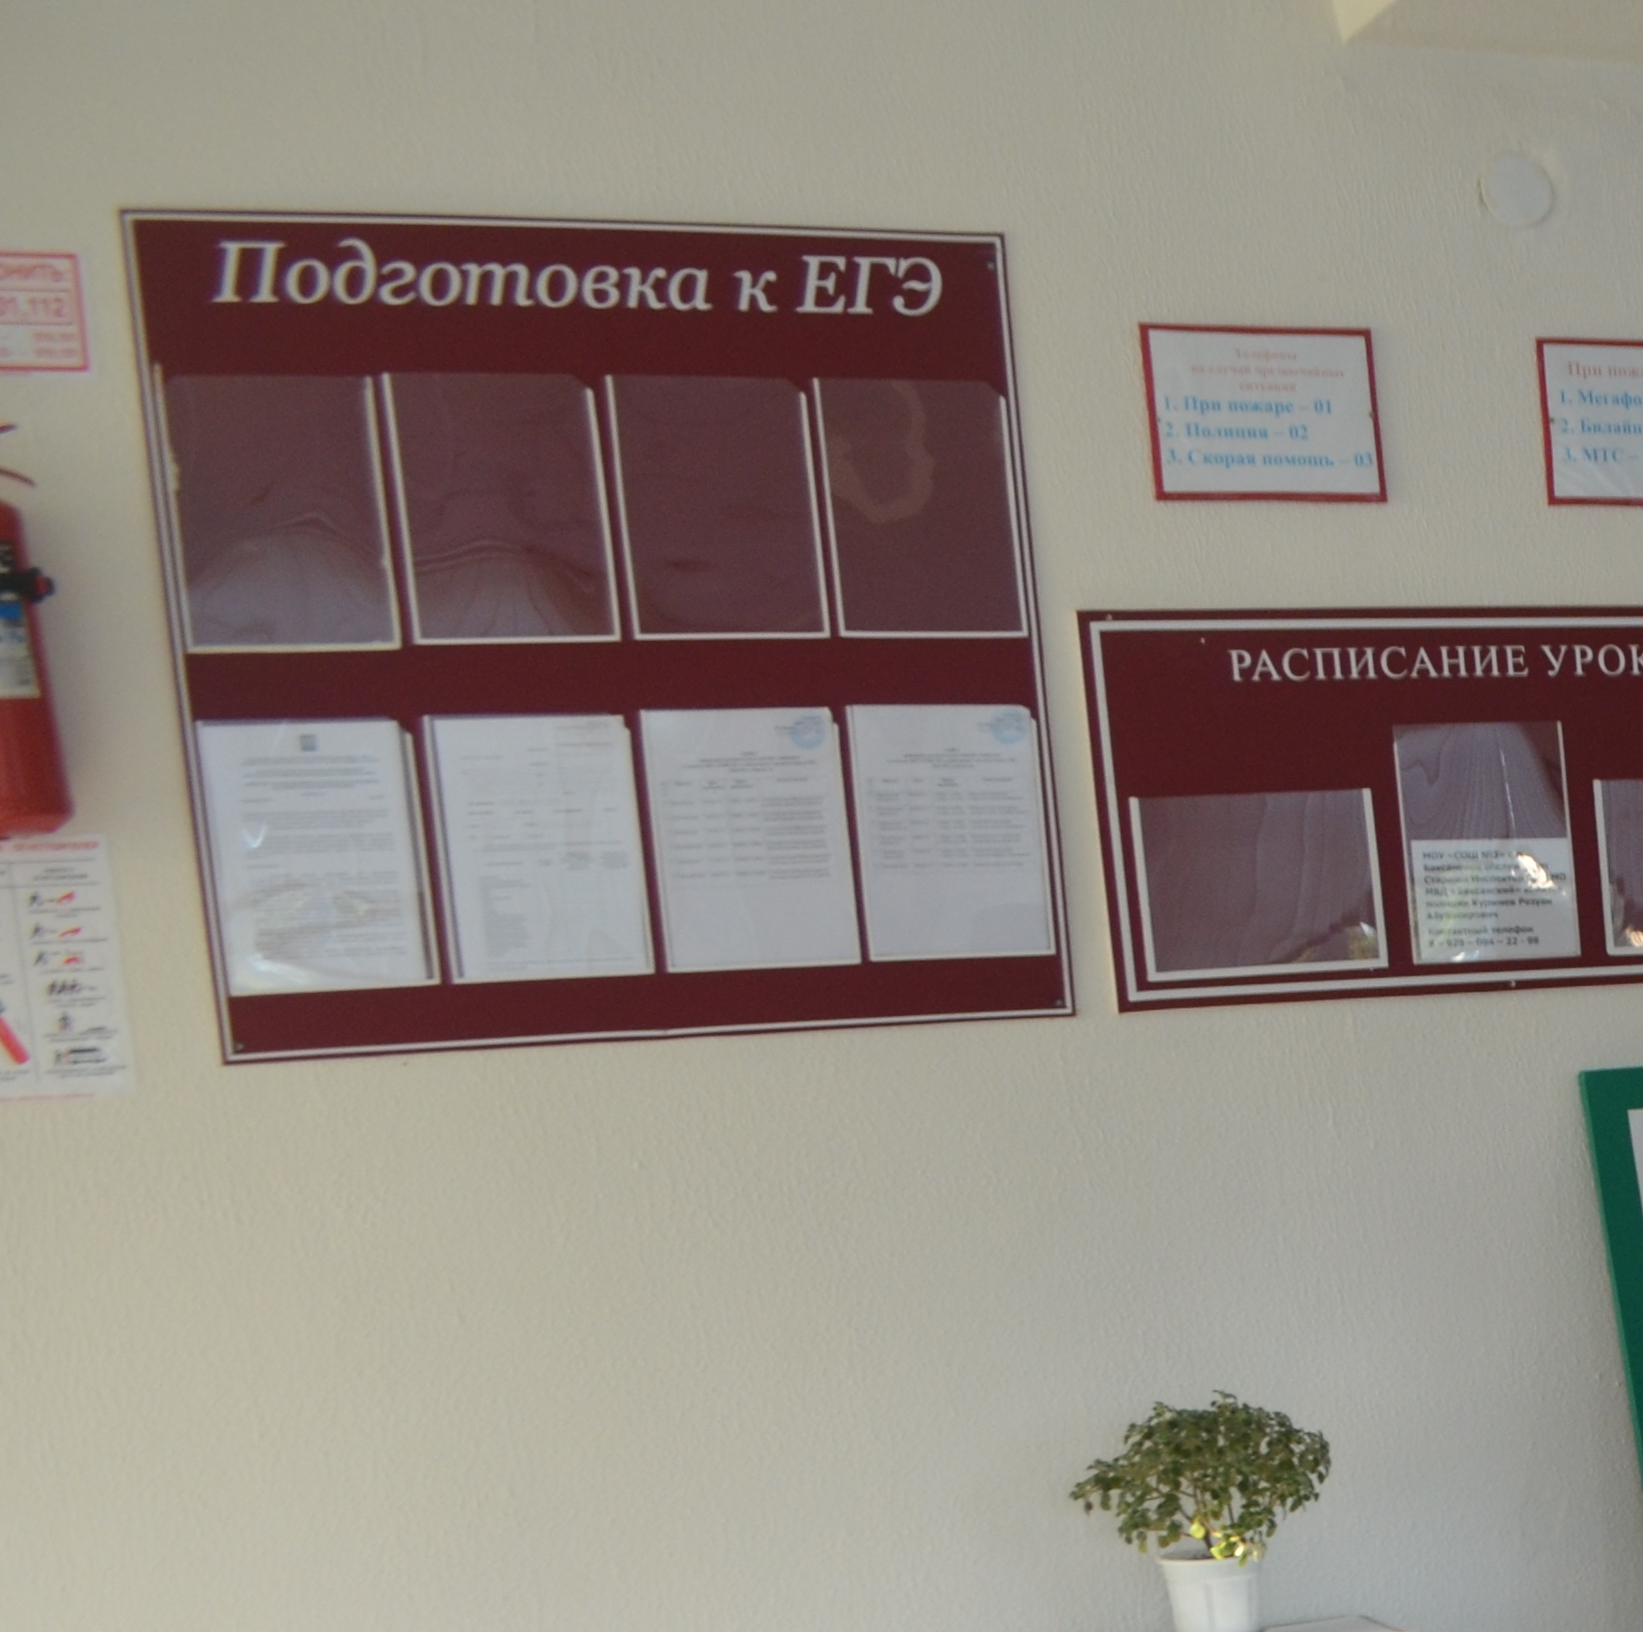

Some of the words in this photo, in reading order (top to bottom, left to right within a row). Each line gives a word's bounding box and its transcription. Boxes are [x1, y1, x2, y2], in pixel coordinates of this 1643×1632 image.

[211, 237, 713, 313] Подготовка
[733, 268, 778, 314] к
[796, 253, 944, 317] ЕГЭ
[1567, 361, 1602, 379] При
[1184, 396, 1222, 415] При
[1228, 402, 1294, 415] пожаре
[1313, 400, 1333, 414] 01
[1185, 423, 1269, 440] Полиция
[1289, 425, 1309, 440] 02
[1579, 419, 1643, 436] Билайн
[1188, 451, 1256, 468] Скорая
[1262, 456, 1335, 467] помощь
[1353, 452, 1374, 467] 03
[1581, 447, 1624, 463] МТС
[1228, 644, 1531, 684] РАСПИСАНИЕ
